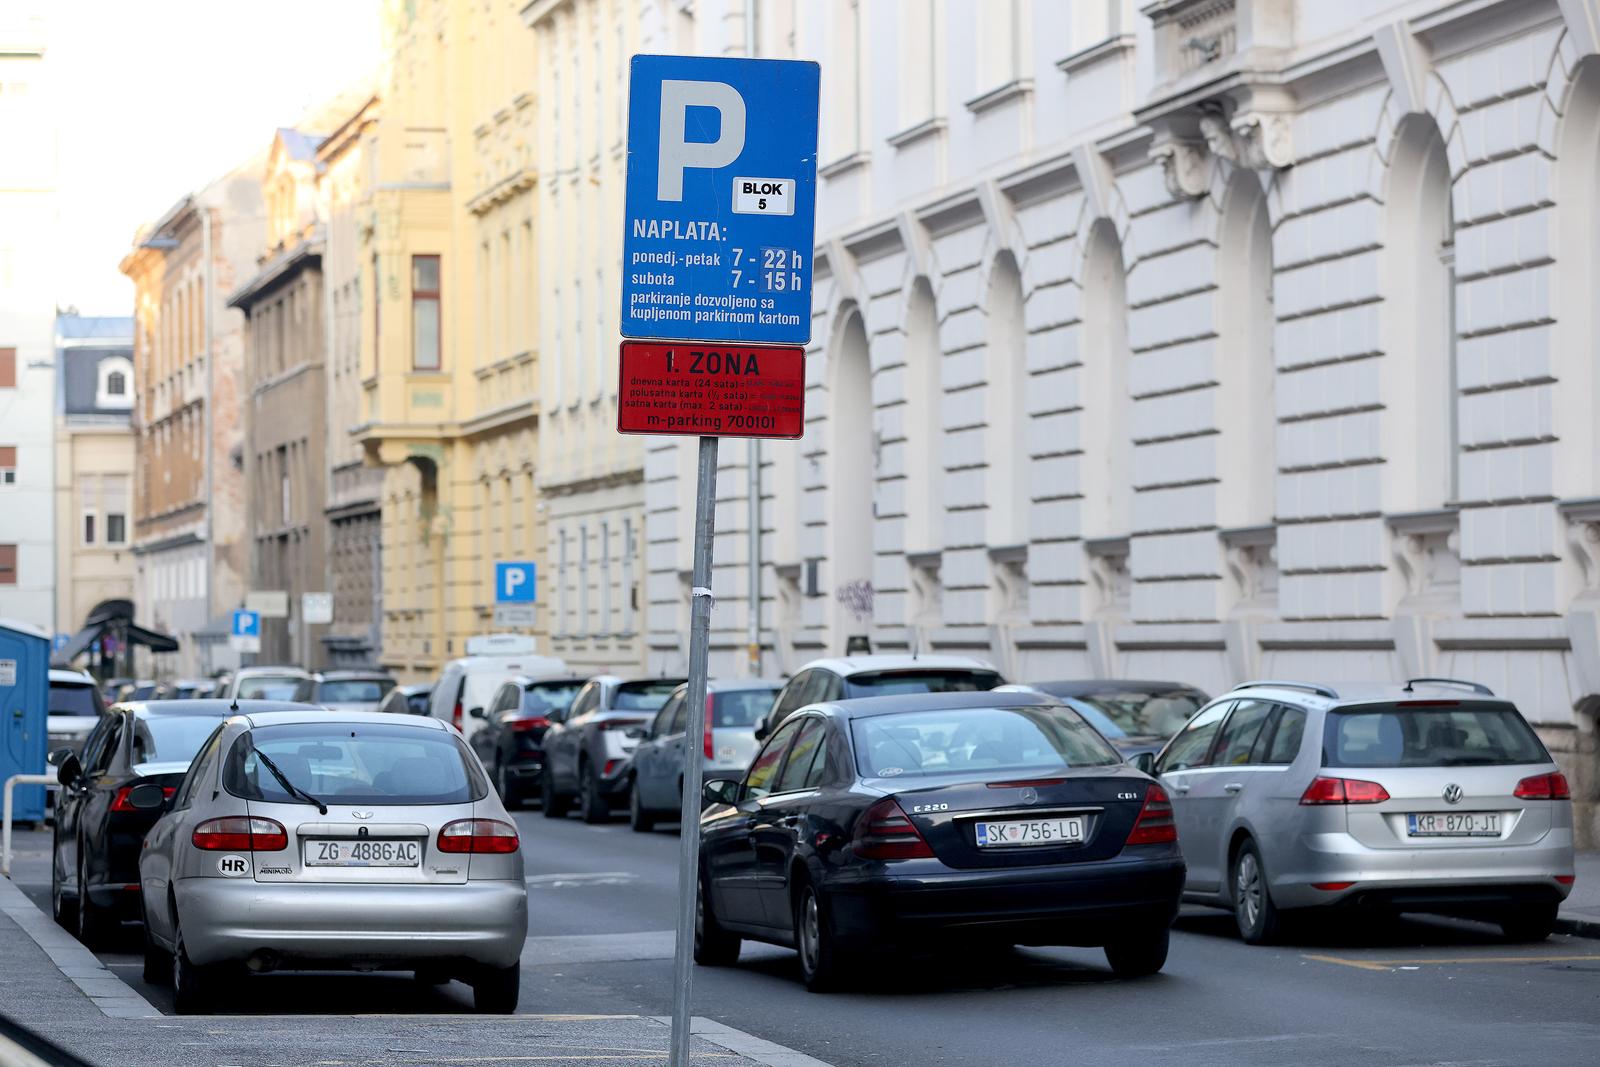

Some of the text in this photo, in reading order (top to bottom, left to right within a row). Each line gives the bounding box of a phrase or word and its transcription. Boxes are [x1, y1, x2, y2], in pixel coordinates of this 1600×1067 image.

[658, 80, 746, 201] P
[743, 183, 782, 195] BLOK
[758, 199, 766, 210] 5
[633, 219, 727, 241] NAPLATA:
[732, 248, 743, 266] 7
[764, 250, 786, 269] 22
[791, 251, 802, 269] h
[631, 272, 675, 286] subota
[731, 270, 743, 288] 7
[764, 271, 786, 291] 15
[791, 272, 801, 290] h
[631, 292, 774, 311] parkiranje dozvoljeno sa
[630, 306, 800, 325] kupljenom parkirnom kartom
[689, 351, 759, 376] ZONA
[630, 376, 662, 386] dnevna
[665, 377, 690, 387] karta
[694, 378, 711, 389] (24
[629, 387, 677, 398] polusatna
[679, 389, 703, 399] karta
[723, 391, 748, 401] sata)
[624, 400, 651, 408] satna
[653, 399, 677, 409] karta
[709, 401, 716, 410] 2
[647, 414, 775, 430] m-parking 700101
[505, 567, 526, 596] P
[1117, 792, 1137, 800] CDI
[913, 803, 948, 813] E 220
[988, 821, 1080, 842] SK 756-LD
[1418, 815, 1497, 831] KR 870-JT
[318, 842, 339, 860] ZG
[222, 860, 245, 872] HR
